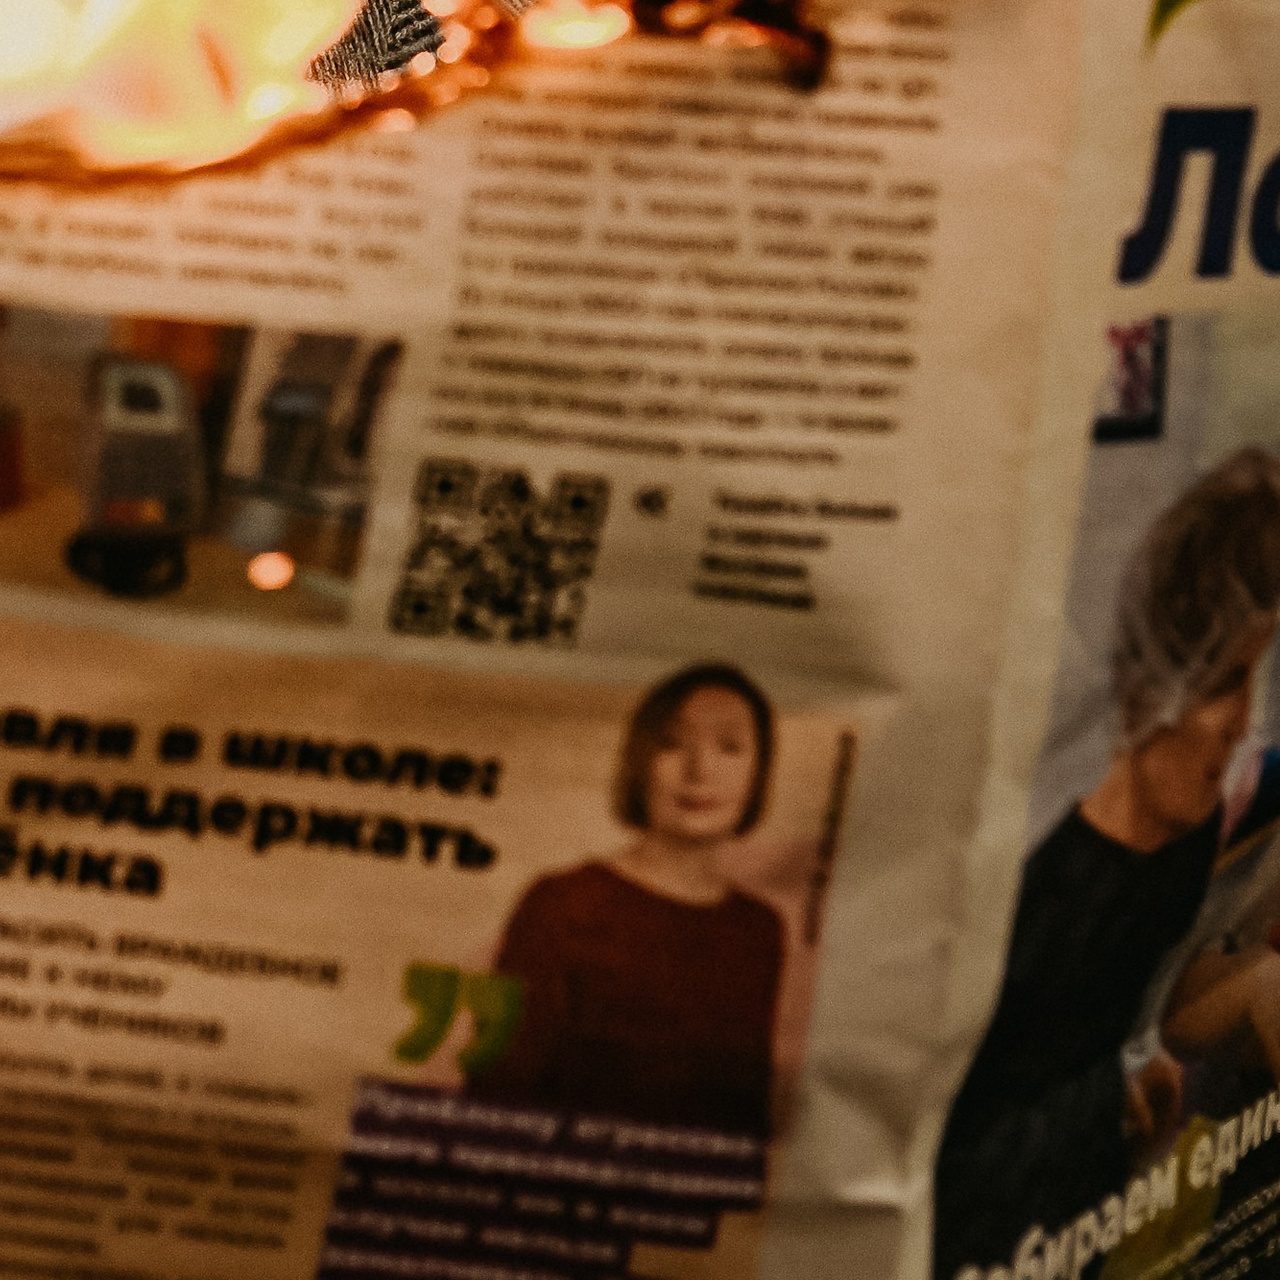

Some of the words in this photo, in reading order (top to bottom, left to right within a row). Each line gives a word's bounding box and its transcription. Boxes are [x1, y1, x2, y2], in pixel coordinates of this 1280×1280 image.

[1116, 105, 1280, 285] Л
[158, 724, 202, 765] в
[223, 730, 501, 798] школе:
[9, 770, 499, 870] поддержать
[956, 1152, 1177, 1280] бираем
